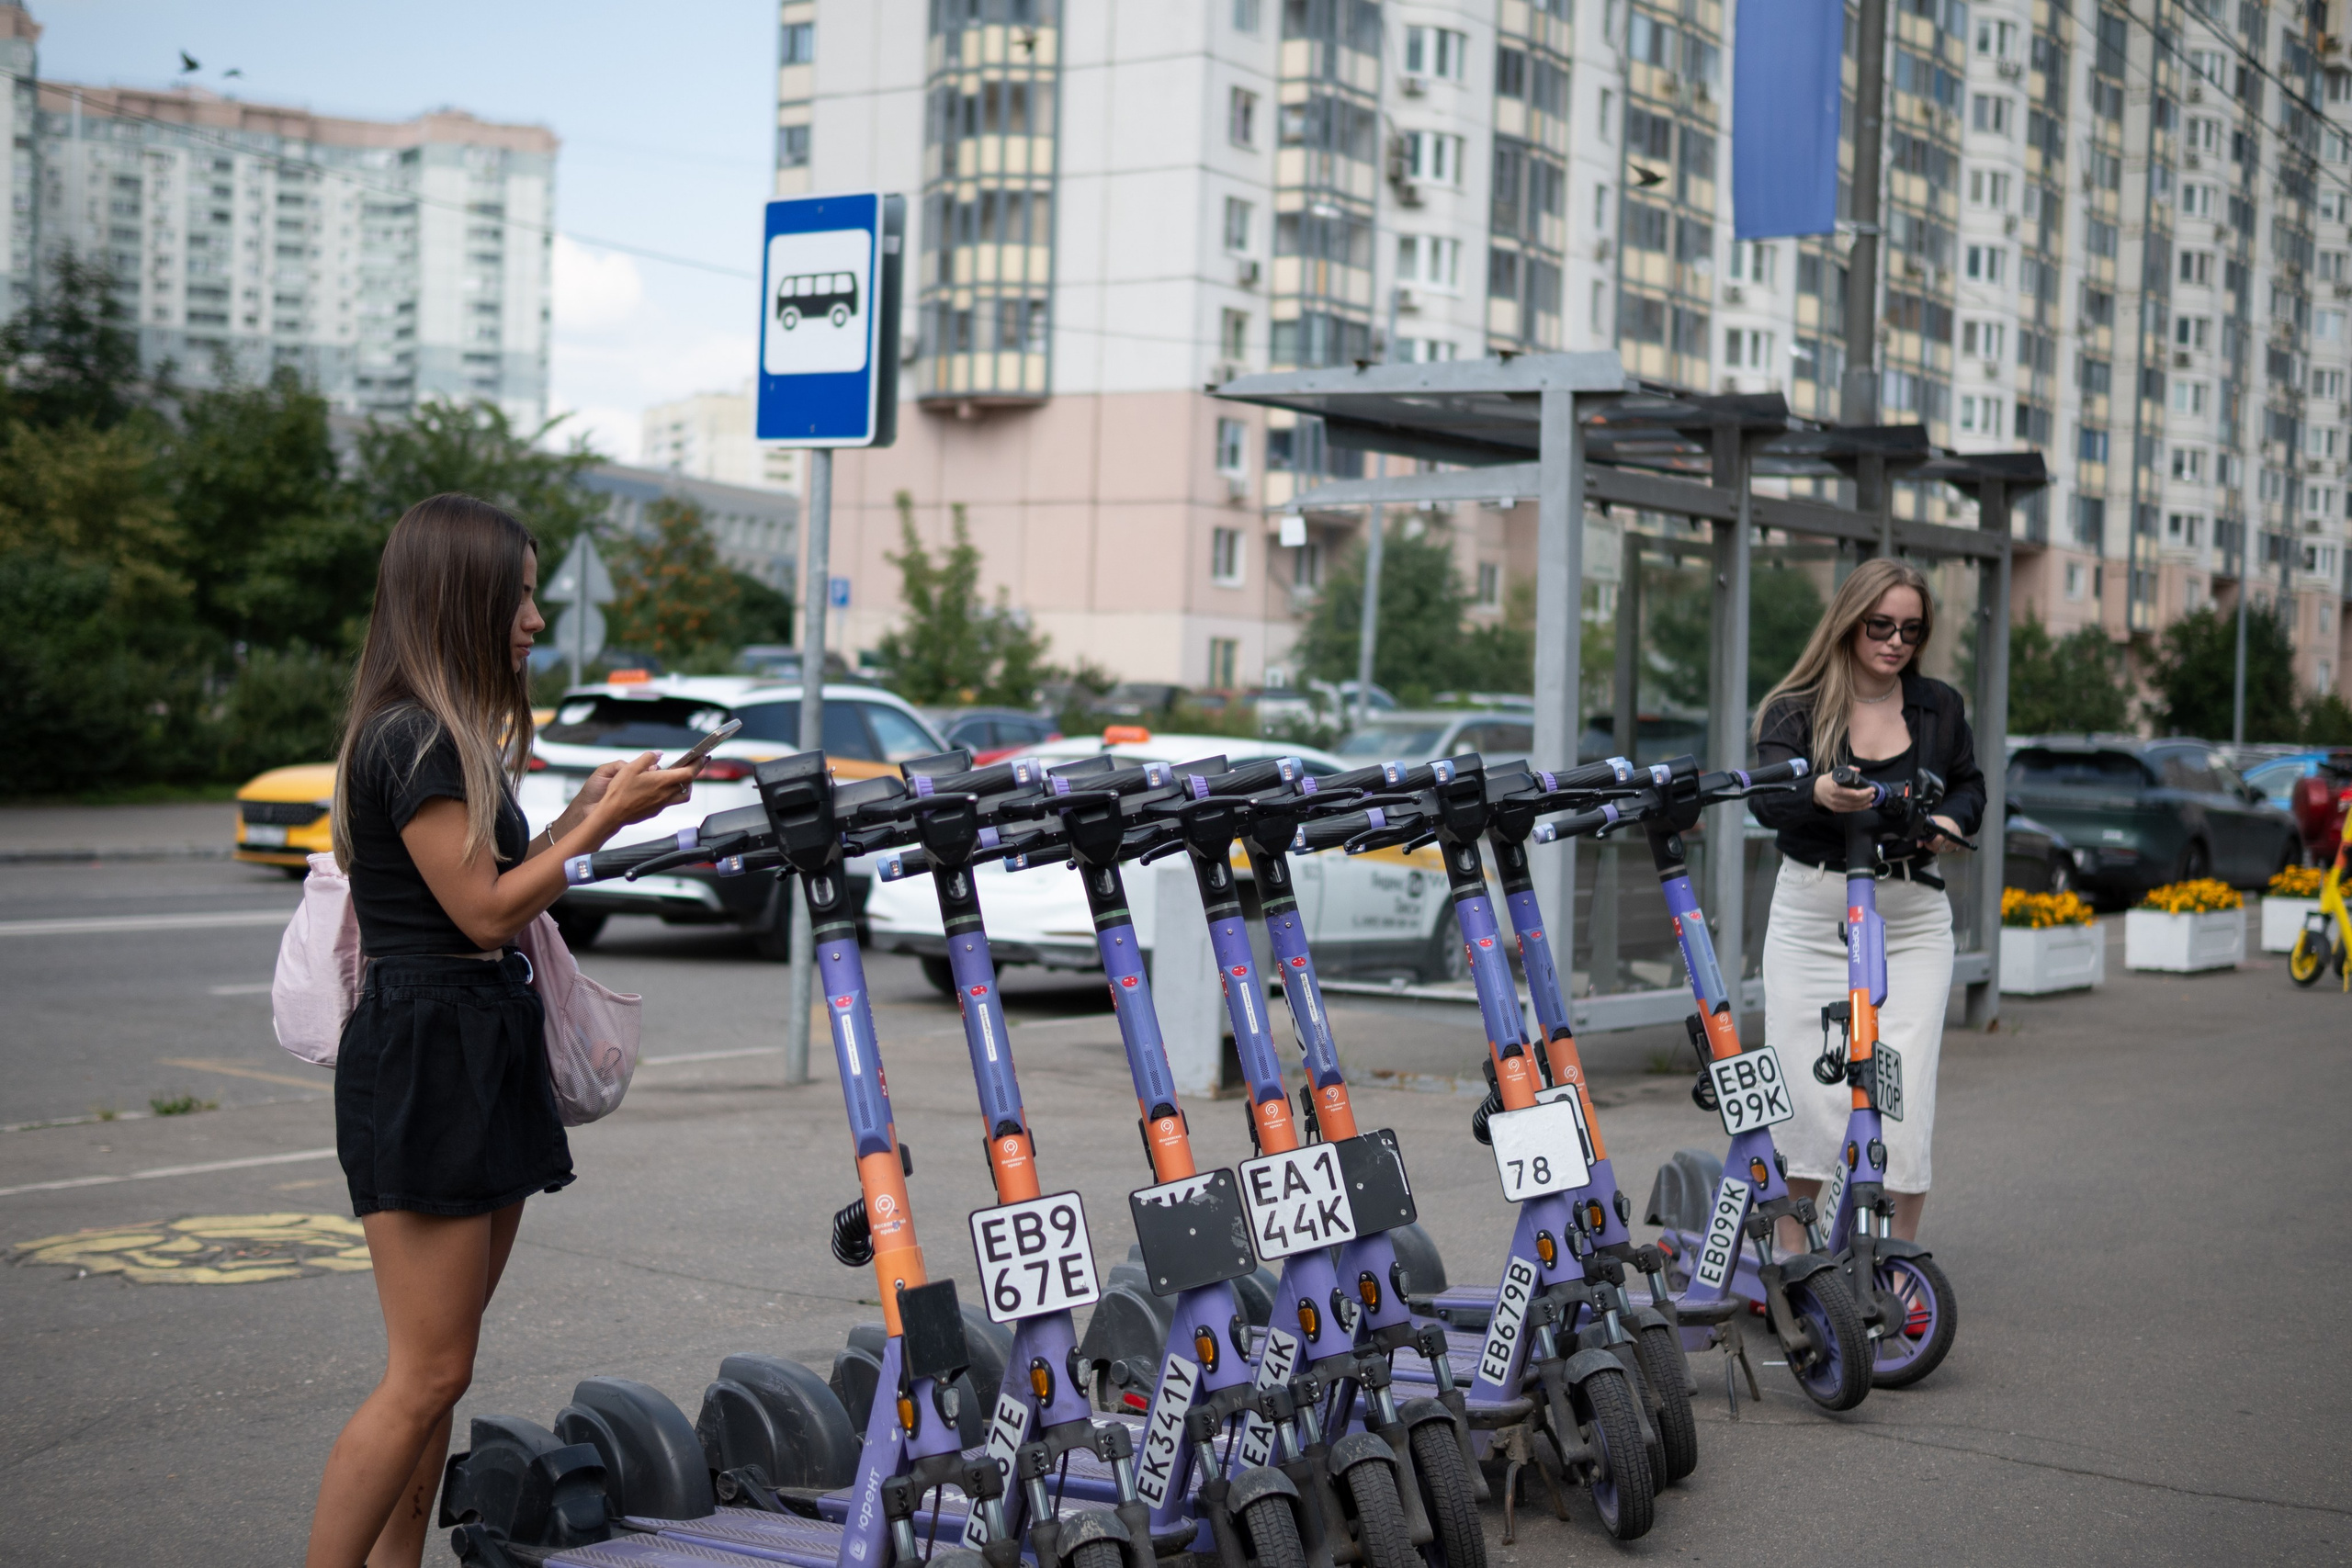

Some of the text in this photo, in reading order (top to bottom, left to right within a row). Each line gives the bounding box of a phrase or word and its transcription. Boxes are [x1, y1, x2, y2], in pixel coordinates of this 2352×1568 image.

[1716, 1055, 1776, 1096] EB0
[1877, 1048, 1900, 1085] EE1
[1725, 1085, 1788, 1128] 99K
[1878, 1077, 1901, 1113] 70P
[1250, 1151, 1337, 1207] EA1
[1507, 1156, 1552, 1190] 78
[981, 1204, 1077, 1263] EB9
[1263, 1195, 1351, 1248] 44K
[1700, 1181, 1746, 1283] EB099K
[994, 1252, 1090, 1313] 67E
[1482, 1263, 1532, 1381] EB679B
